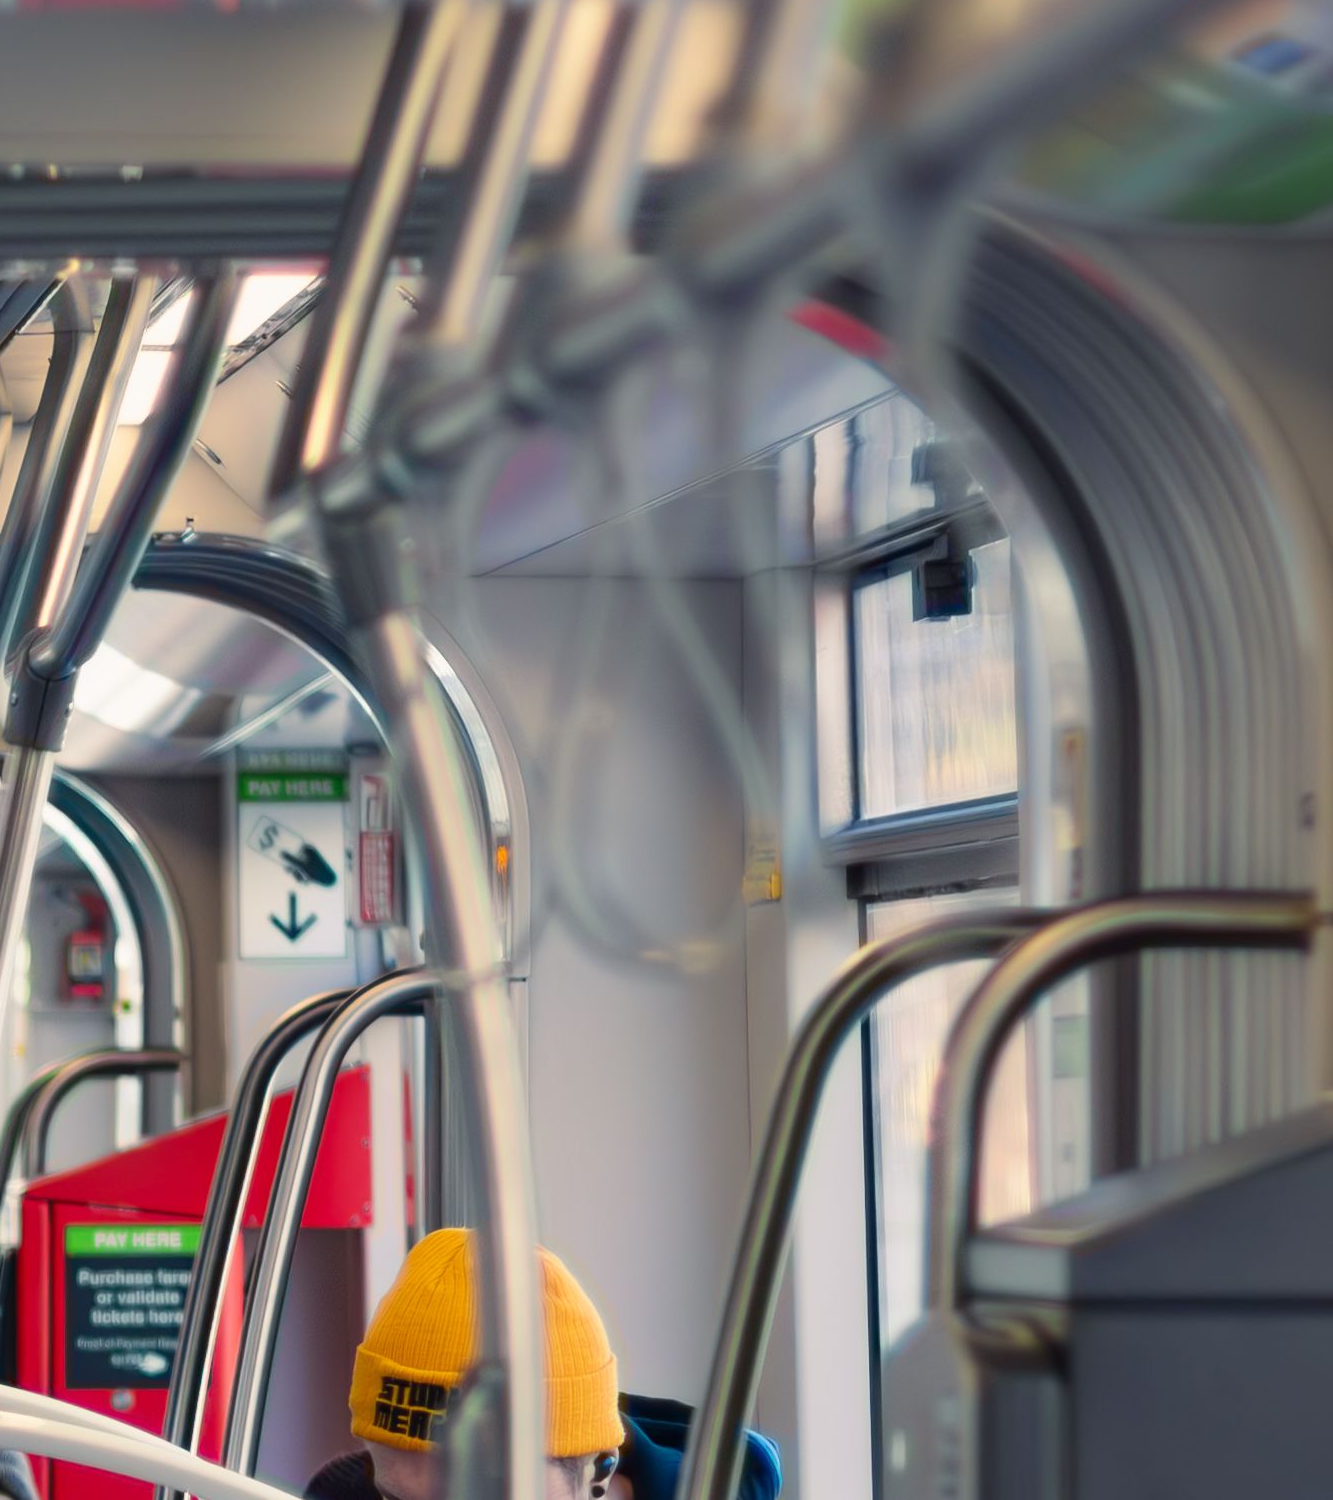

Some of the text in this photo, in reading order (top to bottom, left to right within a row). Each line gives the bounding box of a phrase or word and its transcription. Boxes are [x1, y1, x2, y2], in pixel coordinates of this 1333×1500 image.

[248, 779, 334, 796] PAY HERE
[94, 1231, 181, 1248] PAY HERE
[77, 1268, 154, 1286] Purchase
[96, 1289, 181, 1305] or validate
[91, 1309, 144, 1325] tickets
